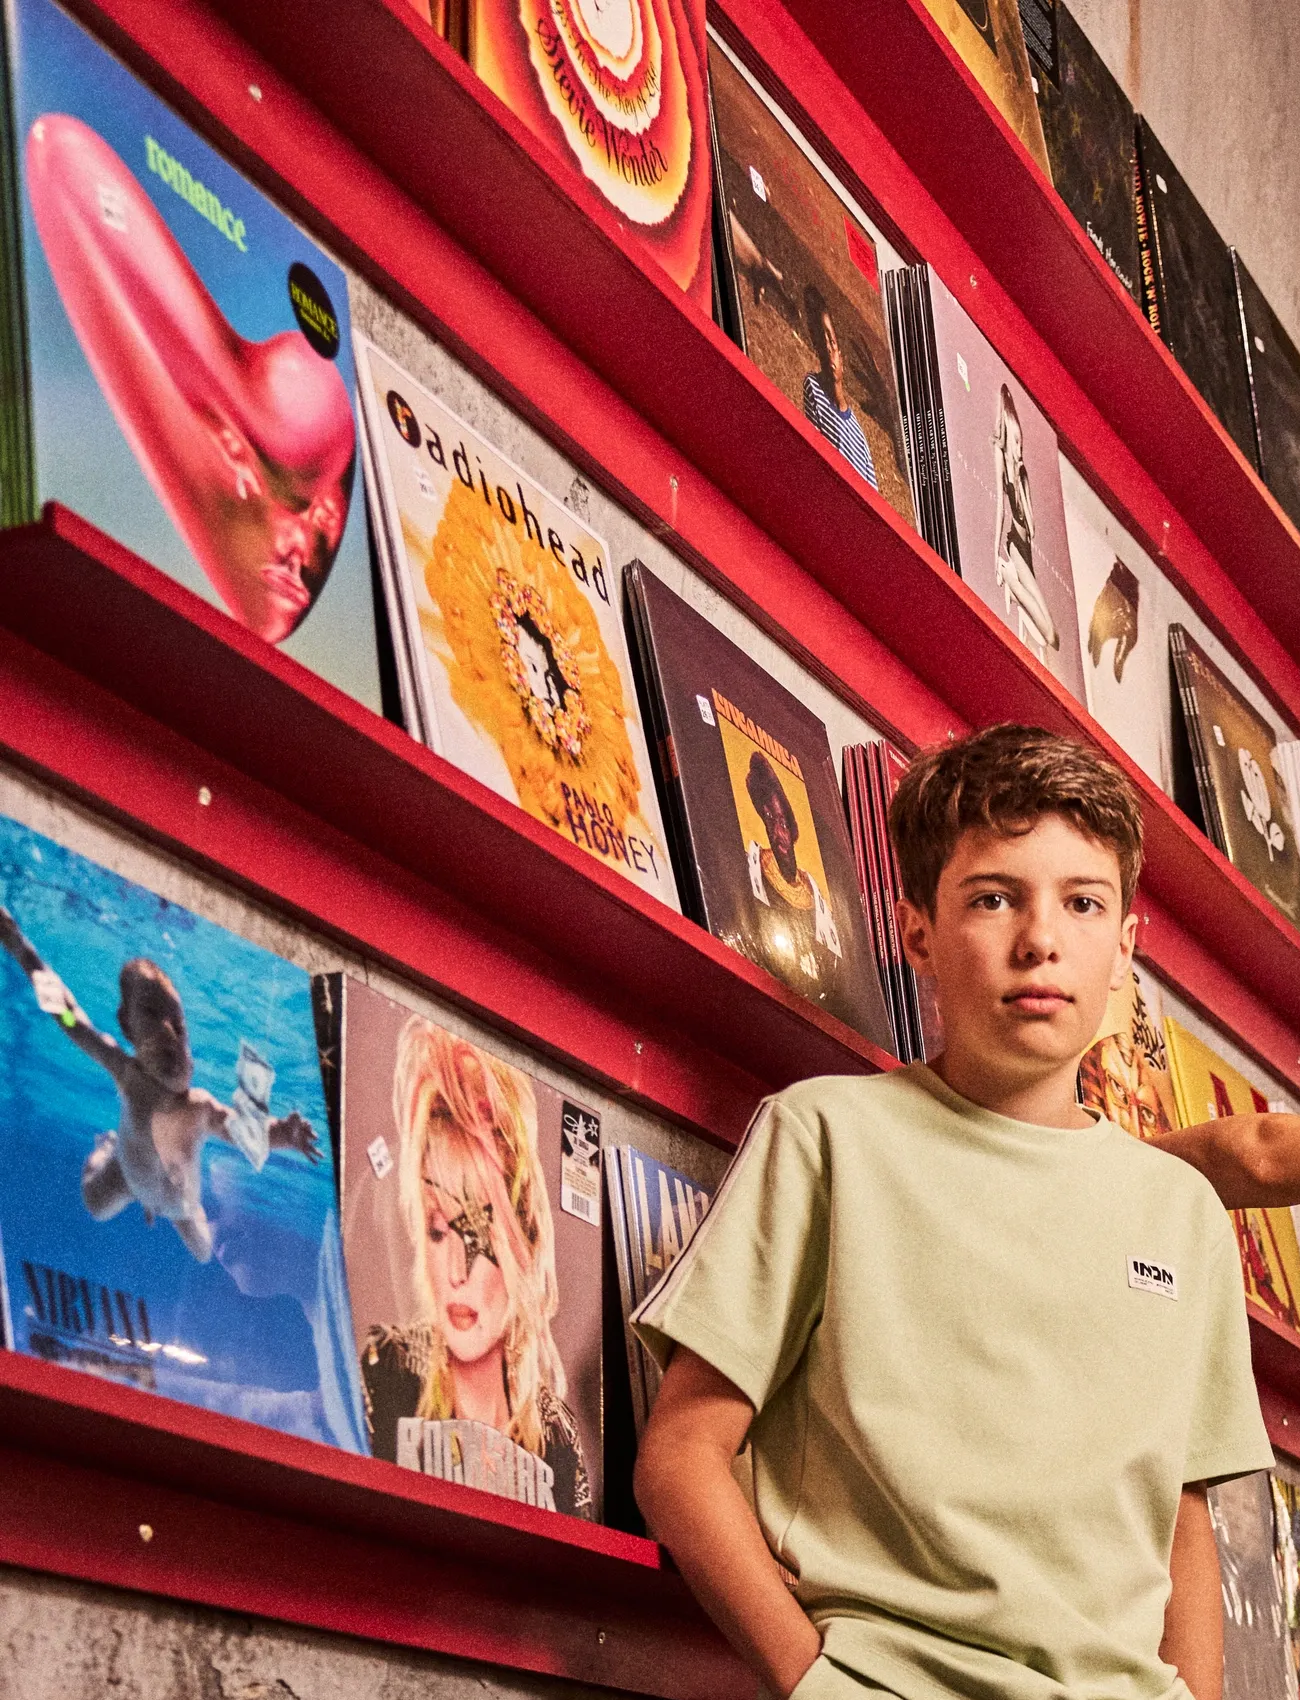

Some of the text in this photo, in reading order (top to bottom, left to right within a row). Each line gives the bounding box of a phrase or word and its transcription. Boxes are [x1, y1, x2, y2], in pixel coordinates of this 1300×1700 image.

[535, 18, 668, 187] Stevie Wonder
[144, 134, 249, 253] romance
[1140, 249, 1155, 286] ROCK
[565, 808, 660, 882] HONEY
[635, 1157, 709, 1275] LAN
